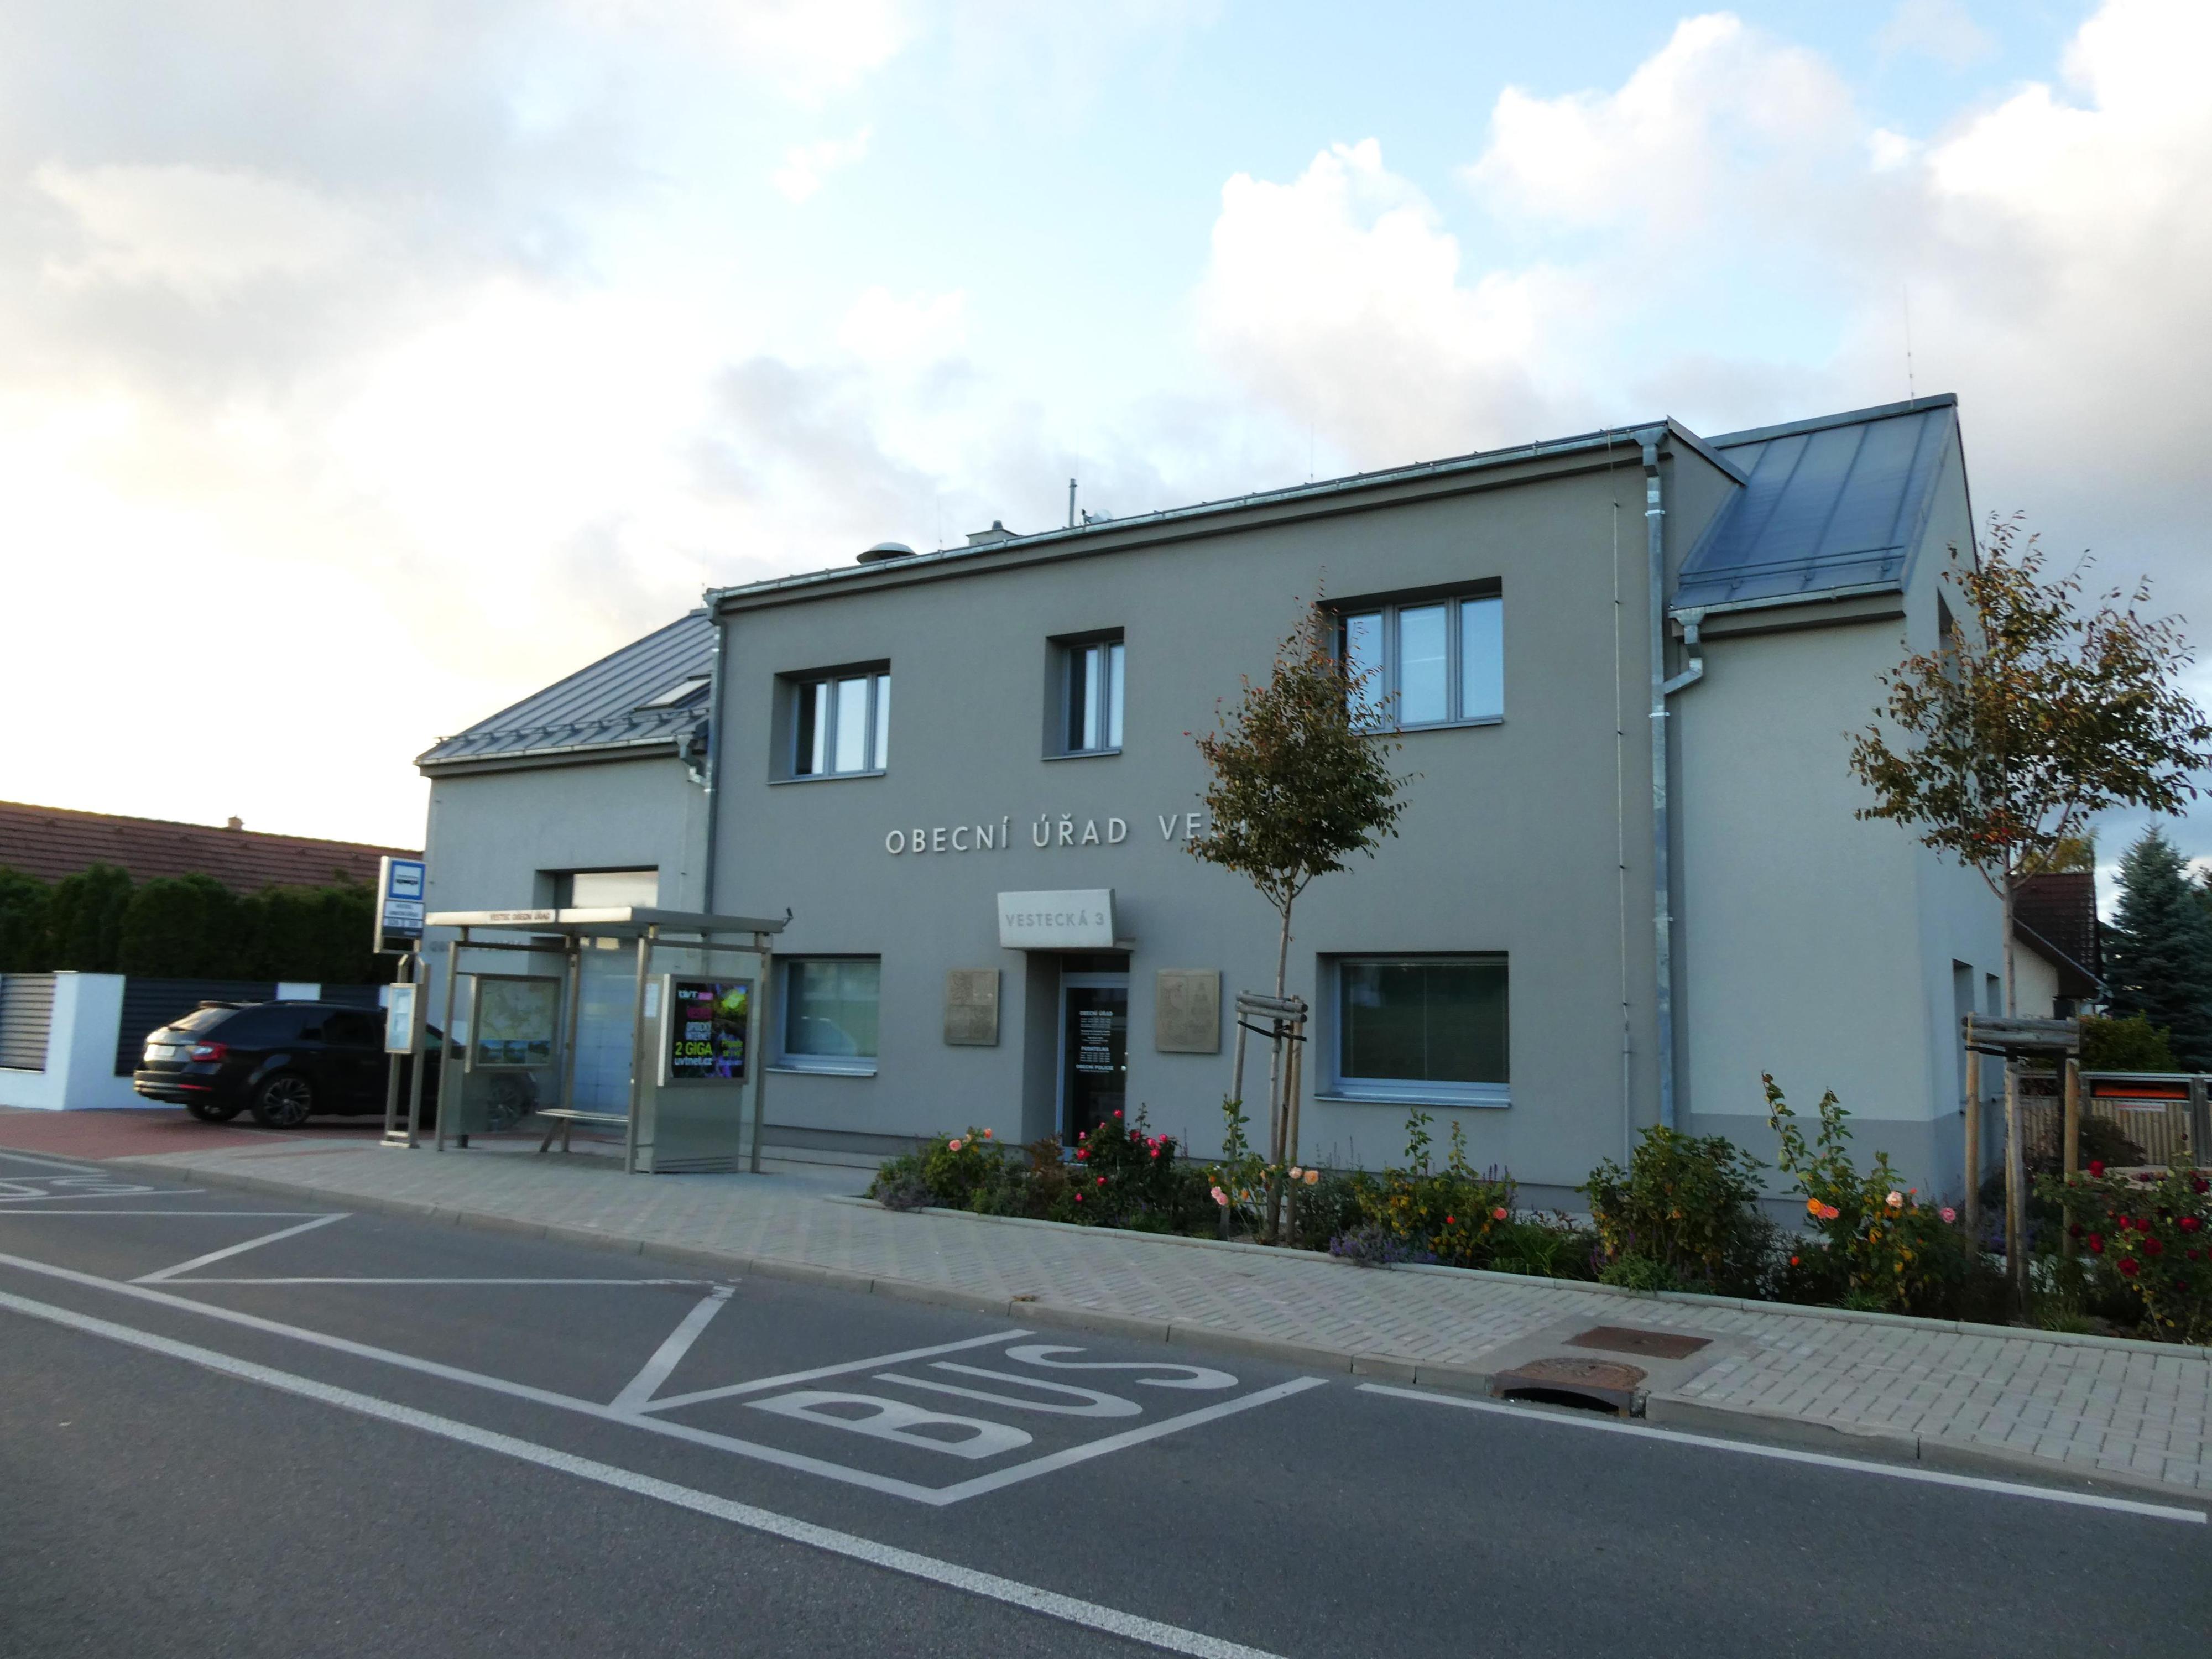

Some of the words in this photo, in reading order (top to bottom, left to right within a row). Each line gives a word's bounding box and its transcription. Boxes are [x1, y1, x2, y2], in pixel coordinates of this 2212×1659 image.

[885, 816, 1009, 854] OBECNÍ
[1032, 813, 1127, 847] ÚŘAD
[1005, 910, 1088, 926] VESTECKÁ
[1095, 913, 1104, 926] 3
[675, 1042, 682, 1055] 2
[685, 1042, 712, 1055] GIGA
[742, 1345, 1239, 1459] BUS
